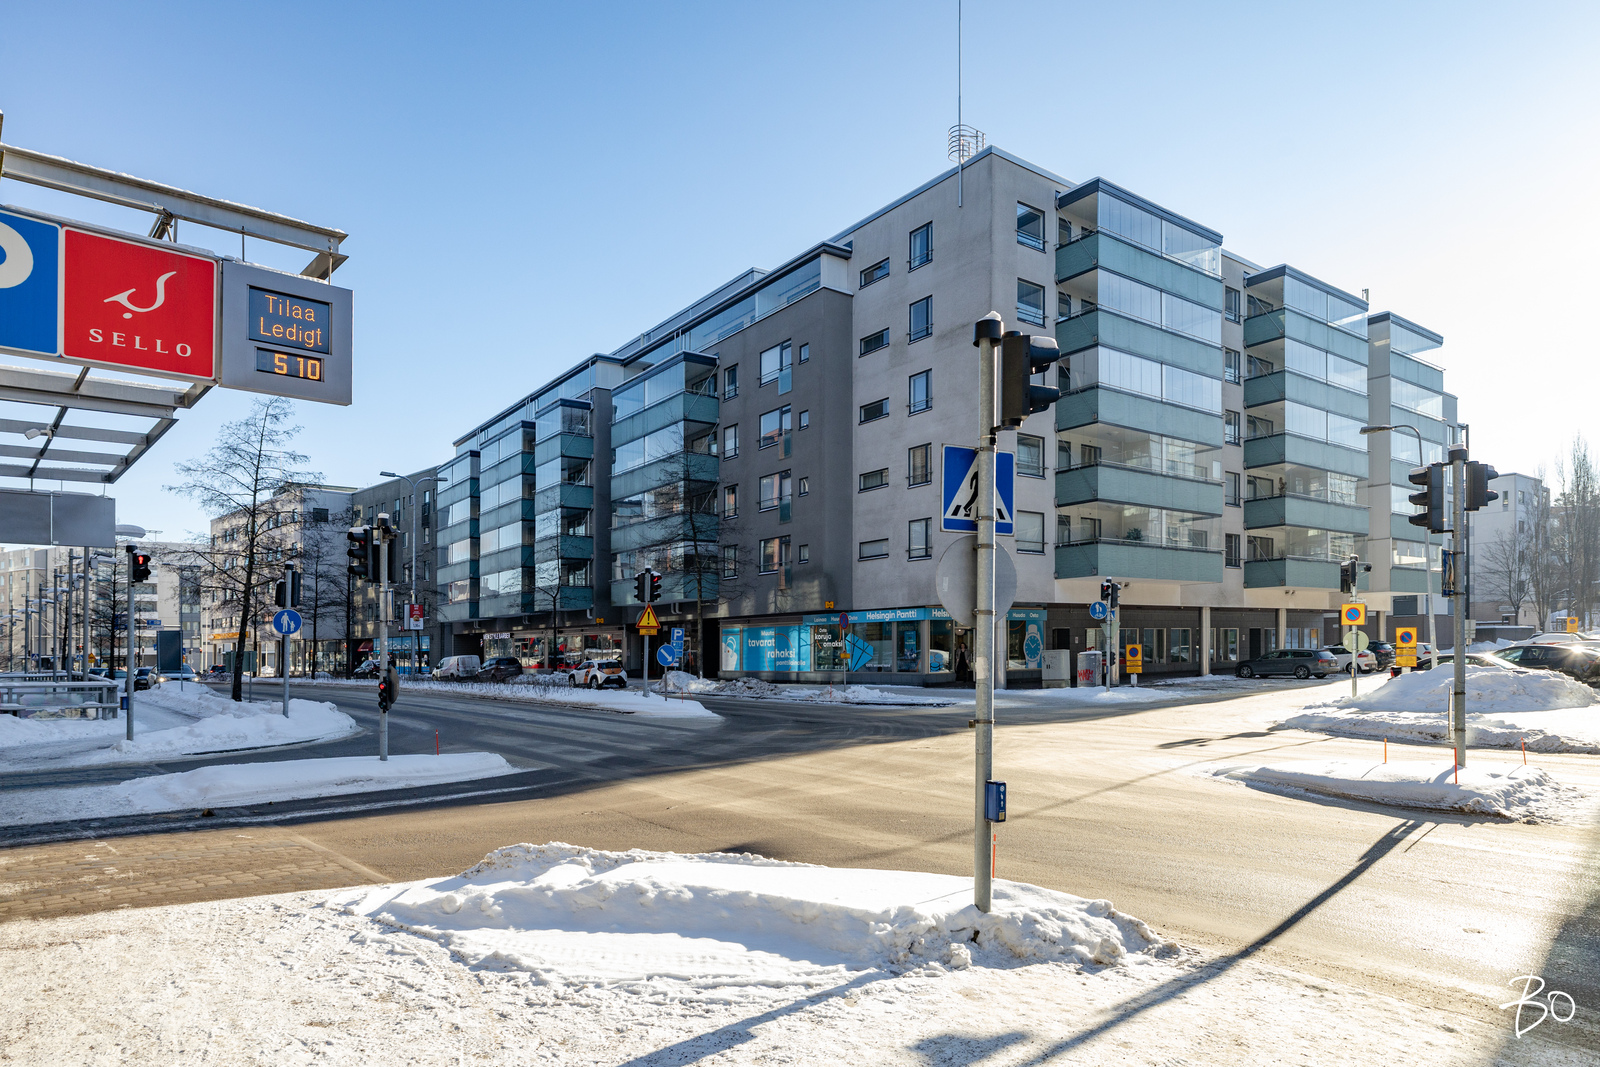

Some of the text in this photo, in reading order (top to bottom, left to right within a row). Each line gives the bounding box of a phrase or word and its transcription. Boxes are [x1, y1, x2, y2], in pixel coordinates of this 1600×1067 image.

[265, 294, 315, 322] Tilaa
[260, 316, 322, 348] Ledigt
[89, 328, 192, 358] SELLO
[866, 610, 917, 621] Helsingin Pantti
[674, 630, 682, 640] P
[748, 638, 775, 647] tavarat
[768, 648, 796, 658] rahaksi
